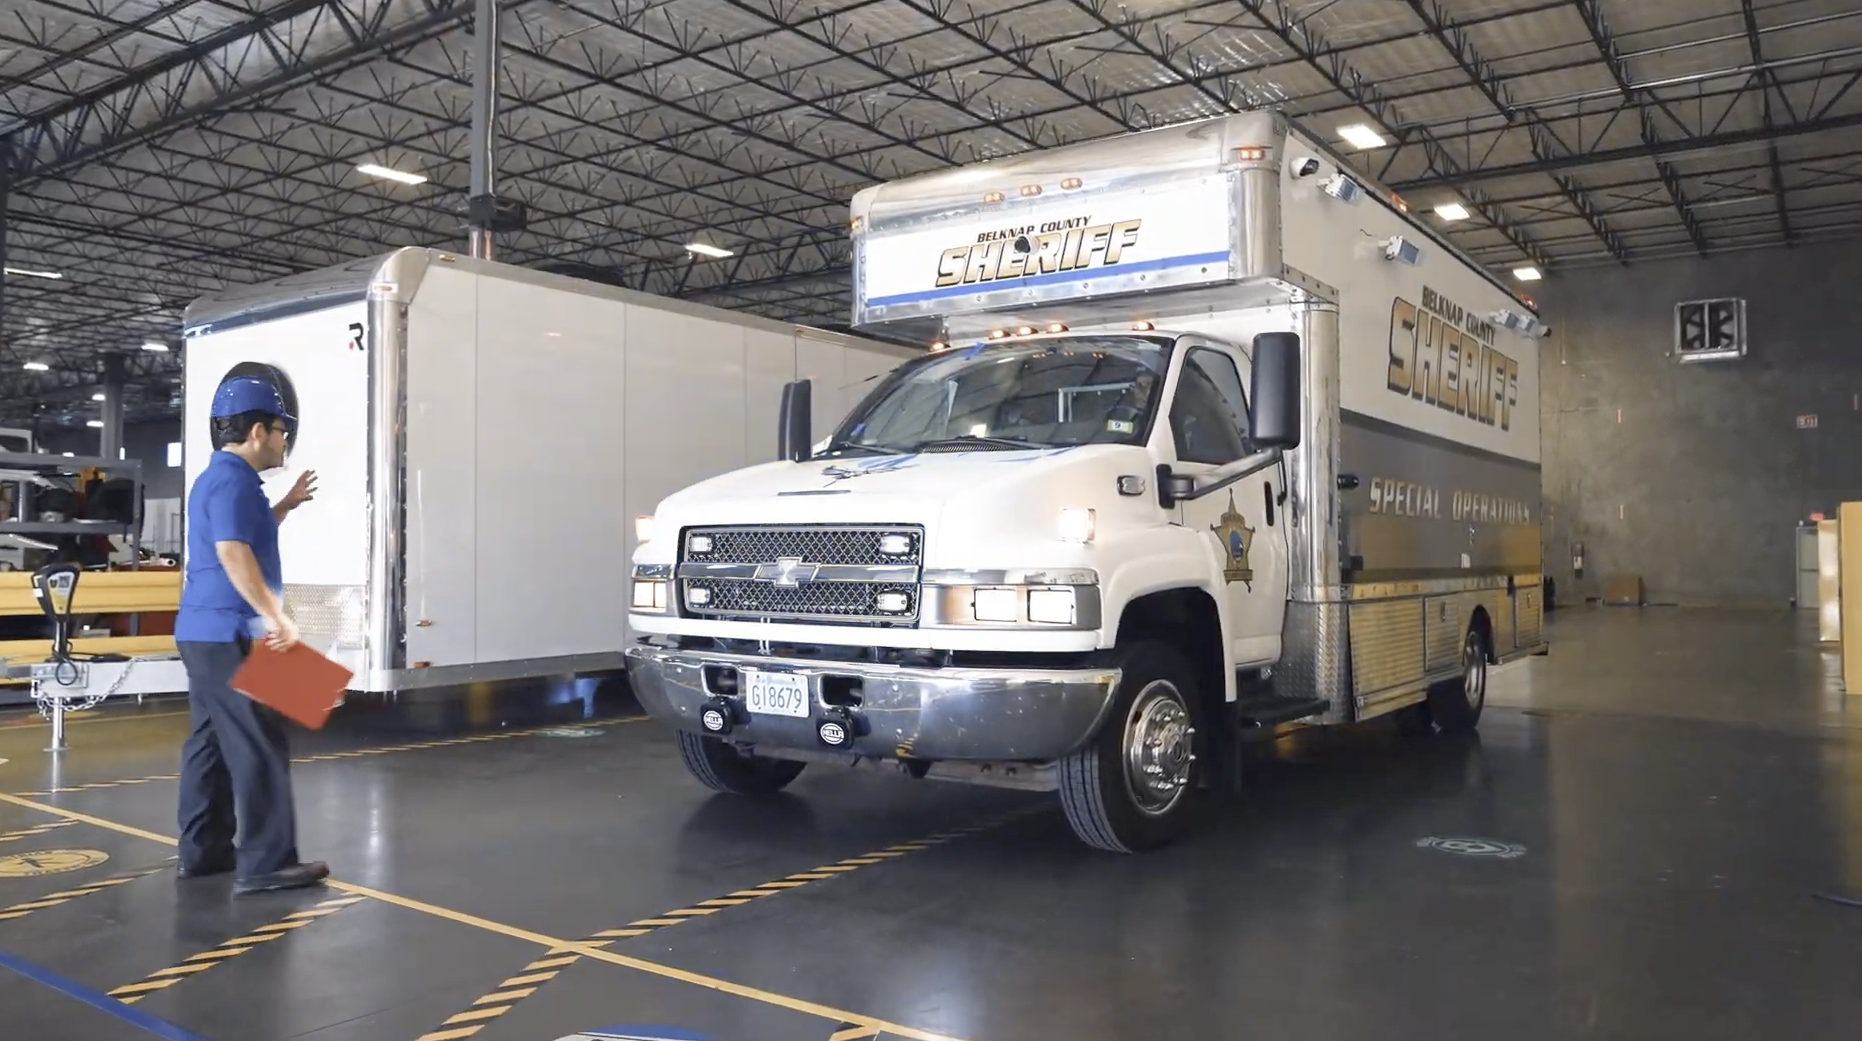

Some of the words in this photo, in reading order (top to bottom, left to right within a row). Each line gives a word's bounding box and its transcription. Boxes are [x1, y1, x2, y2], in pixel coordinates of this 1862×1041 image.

[935, 218, 1142, 287] SHERIFF
[977, 226, 1034, 243] BELKNAP
[1040, 215, 1092, 233] COUNTY
[1422, 284, 1463, 327] BELKNAP
[1466, 312, 1496, 346] COUNTY
[1387, 296, 1518, 431] SHERIFF
[1369, 476, 1442, 519] SPECIAL
[1452, 489, 1530, 525] OPERATIONS
